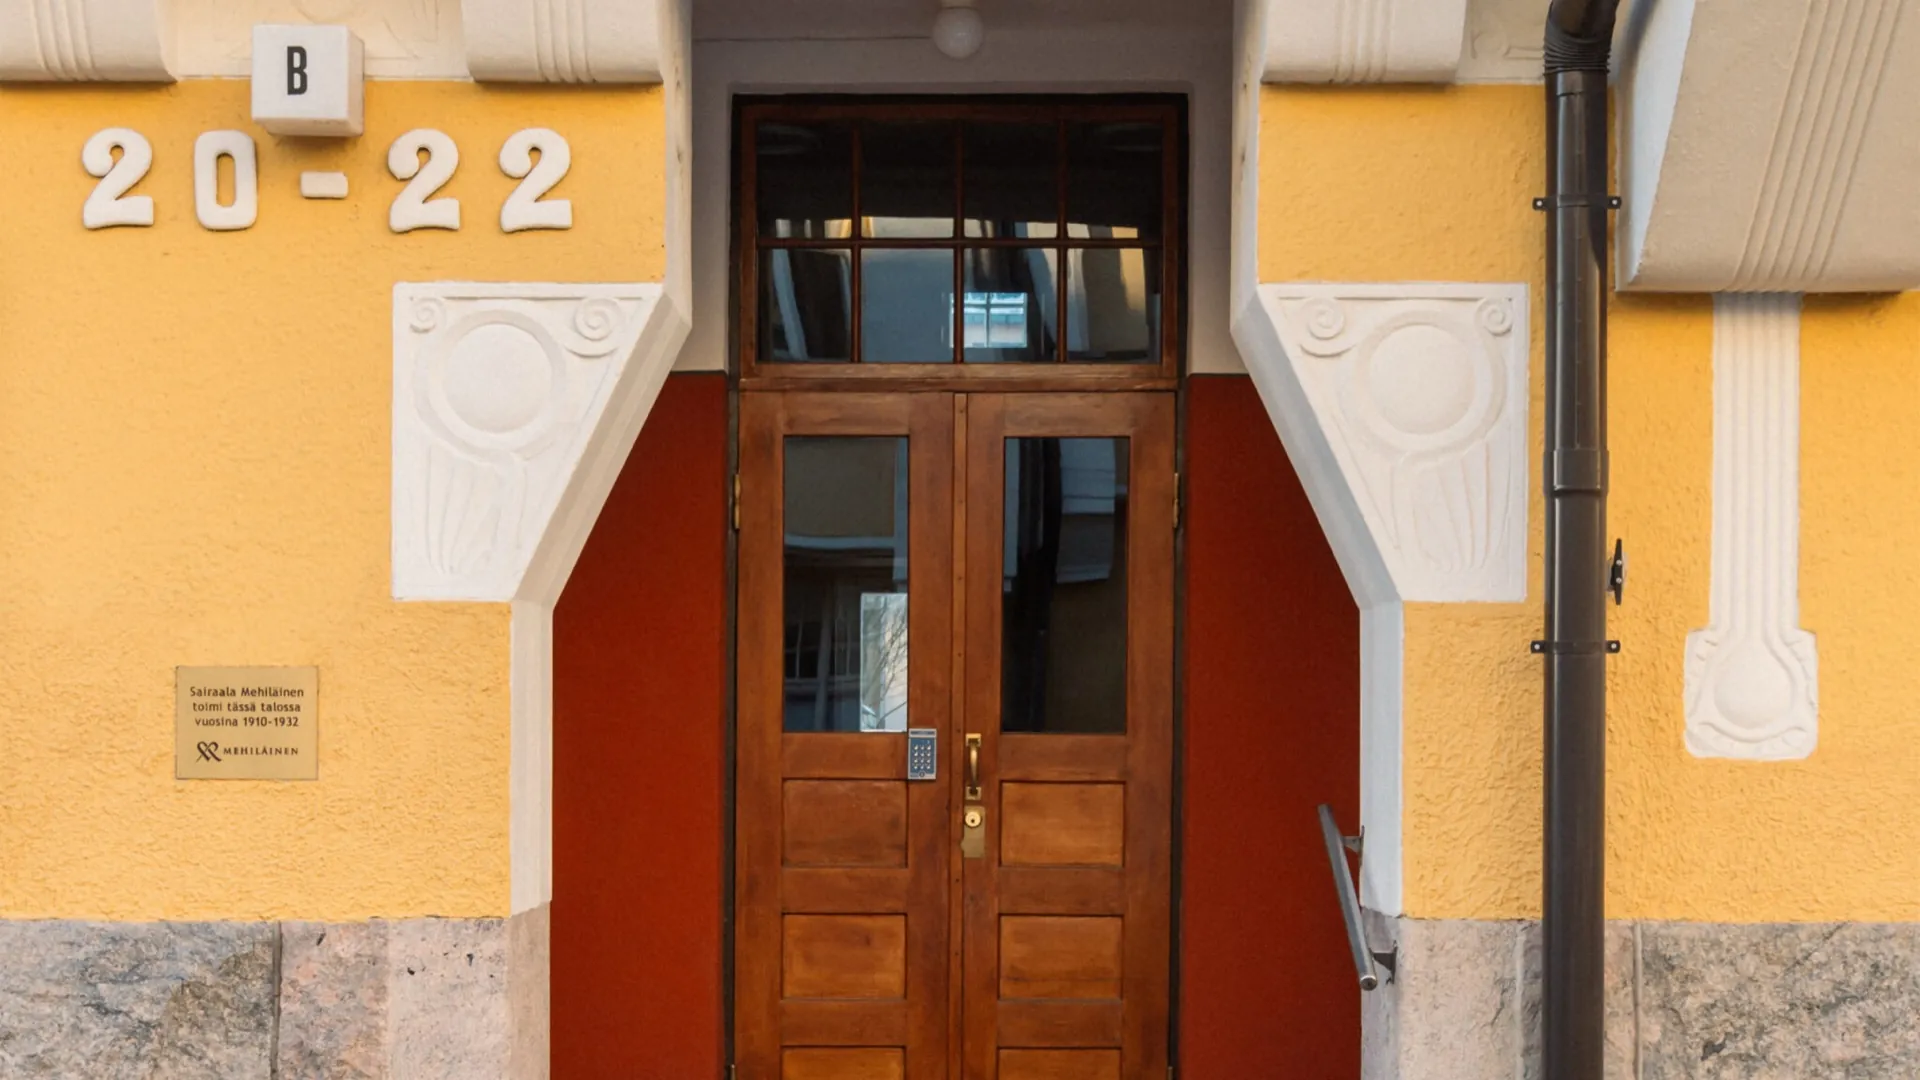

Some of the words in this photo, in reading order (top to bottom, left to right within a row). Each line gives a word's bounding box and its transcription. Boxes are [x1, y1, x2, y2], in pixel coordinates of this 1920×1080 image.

[286, 45, 308, 96] B
[190, 686, 236, 697] Sairaala
[240, 686, 304, 697] Mehiläinen
[192, 702, 222, 712] toimi
[227, 702, 256, 712] tässä
[261, 702, 301, 712] talossa
[195, 717, 238, 727] vuosina
[243, 717, 299, 727] 1910-1932
[223, 745, 299, 755] MEHILÄINEN
